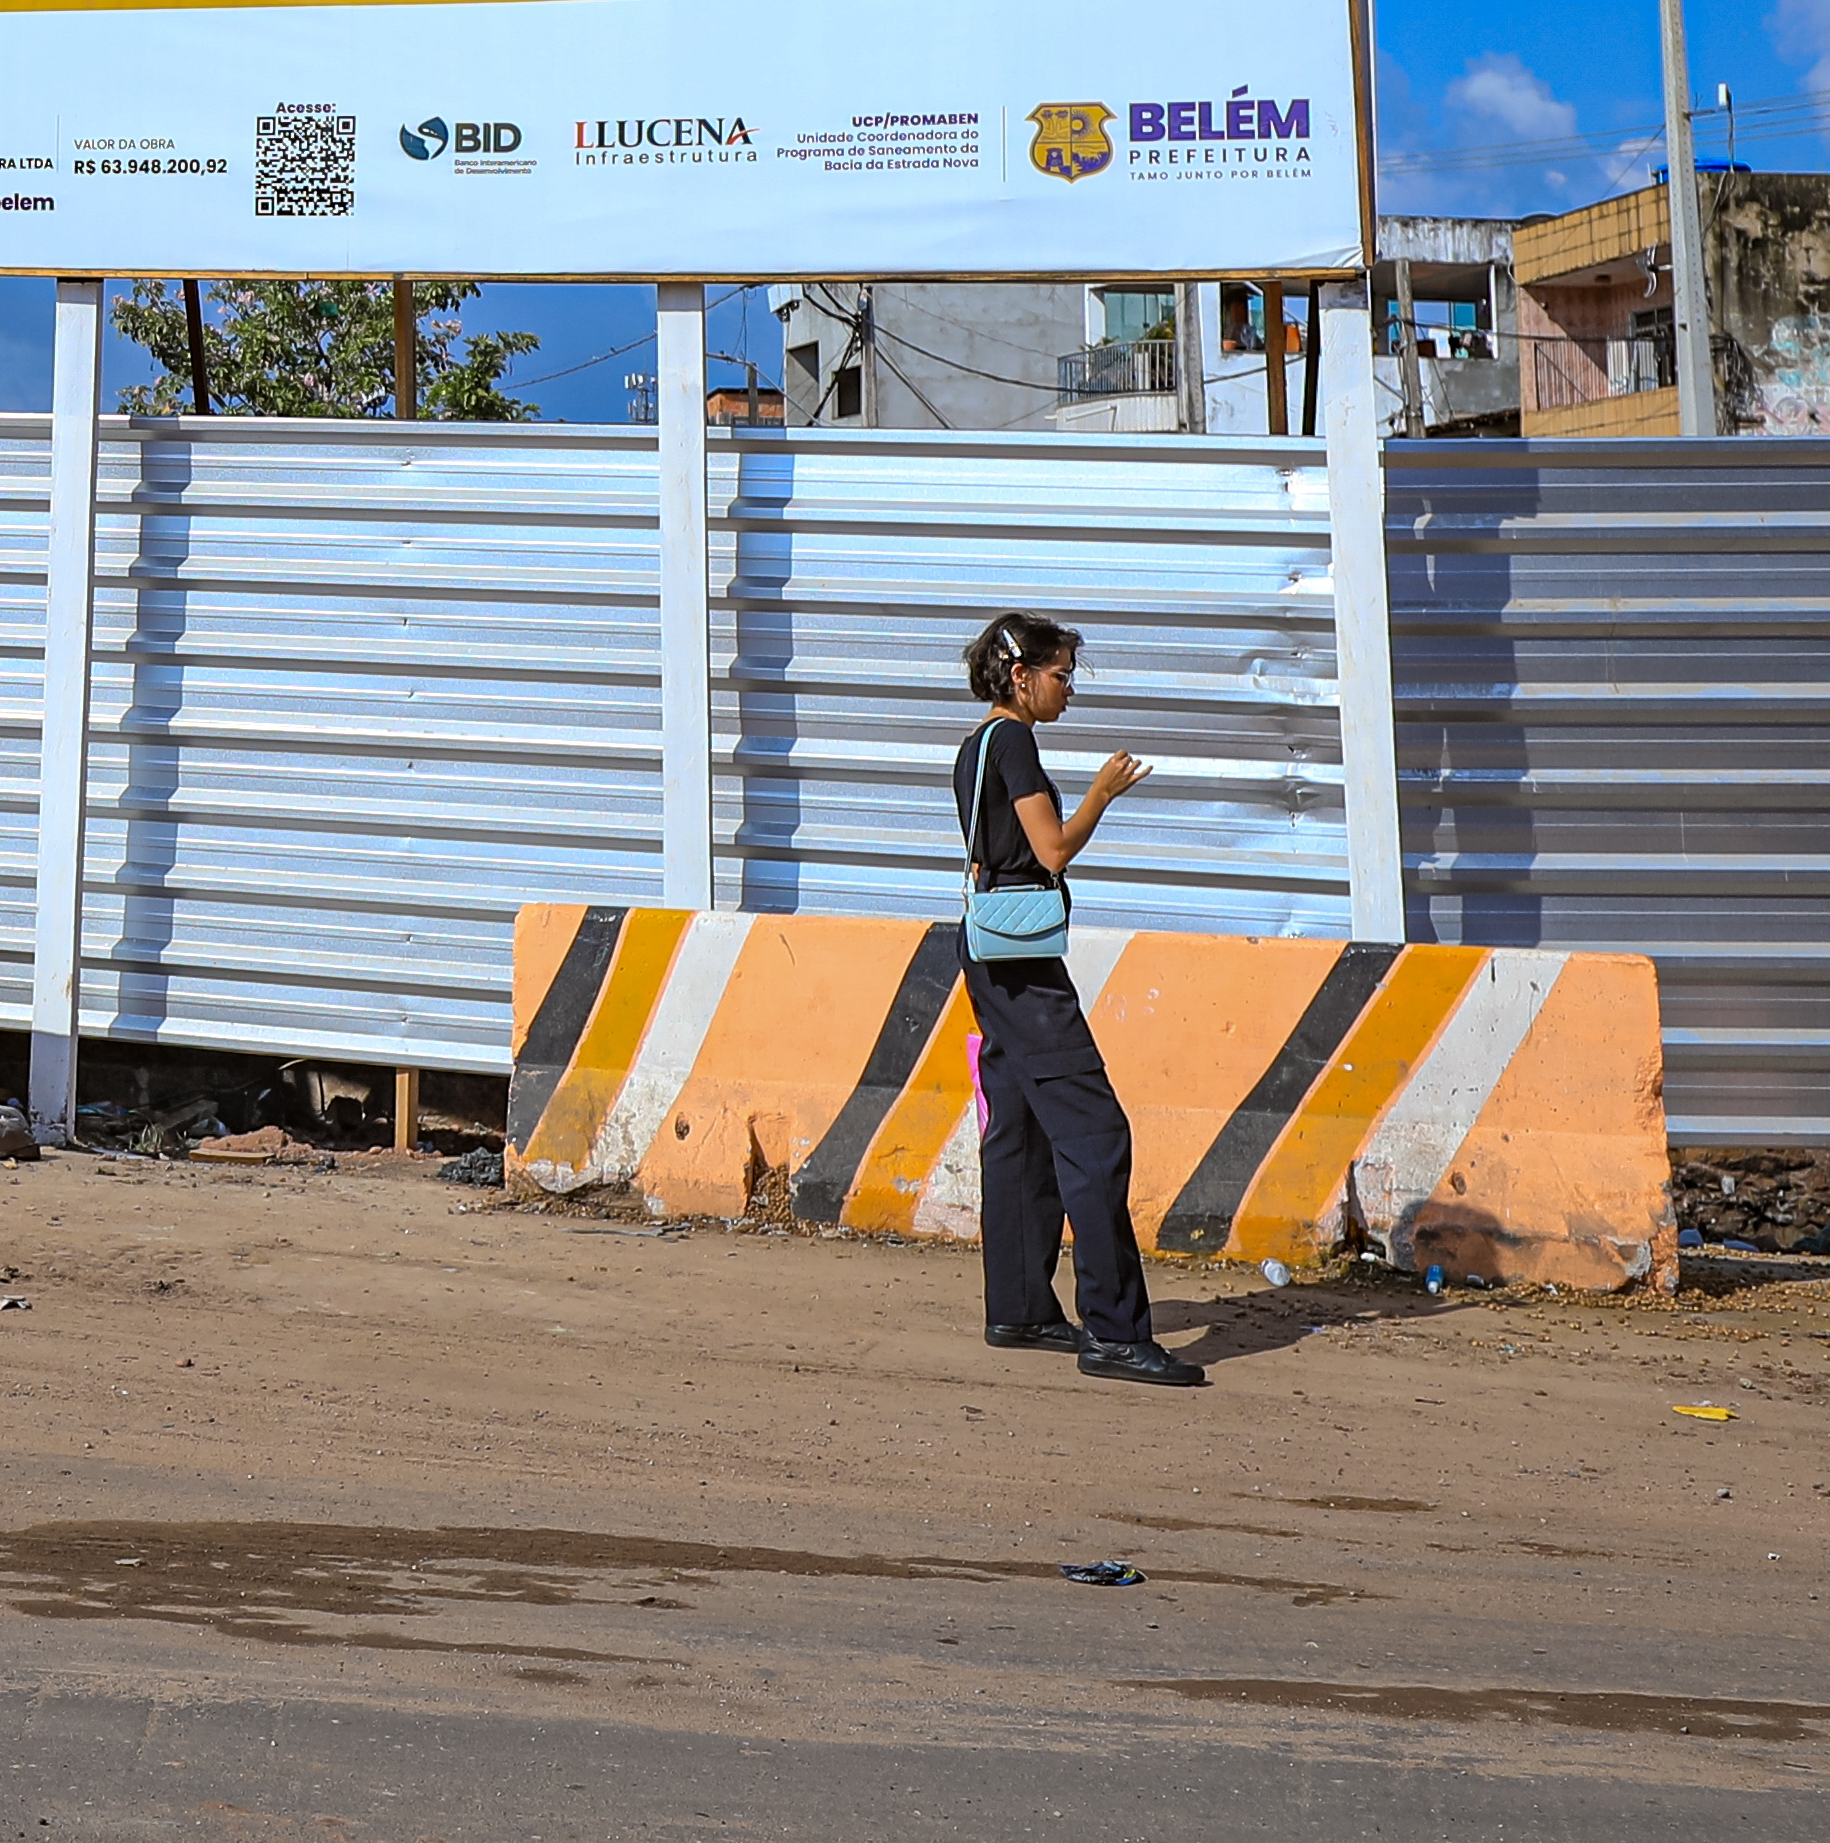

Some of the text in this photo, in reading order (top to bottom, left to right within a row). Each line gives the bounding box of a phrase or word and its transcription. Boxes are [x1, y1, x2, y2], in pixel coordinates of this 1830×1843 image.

[852, 112, 978, 129] UCP/PROMABEN
[1129, 84, 1310, 142] BELÉM
[454, 122, 522, 153] BID
[797, 129, 979, 143] Unidade Coordenadora do
[74, 139, 175, 150] VALOR DA OBRA
[777, 143, 978, 160] Programa de Saneamento da
[576, 151, 757, 165] Infraestrutura
[1130, 147, 1311, 164] PREFEITURA
[20, 158, 54, 169] LTDA
[74, 159, 227, 176] R$ 63.948.200,92
[825, 158, 978, 170] Bacia da Estrada Nova
[1130, 168, 1311, 180] TAMO JUNTO POR BELÉM
